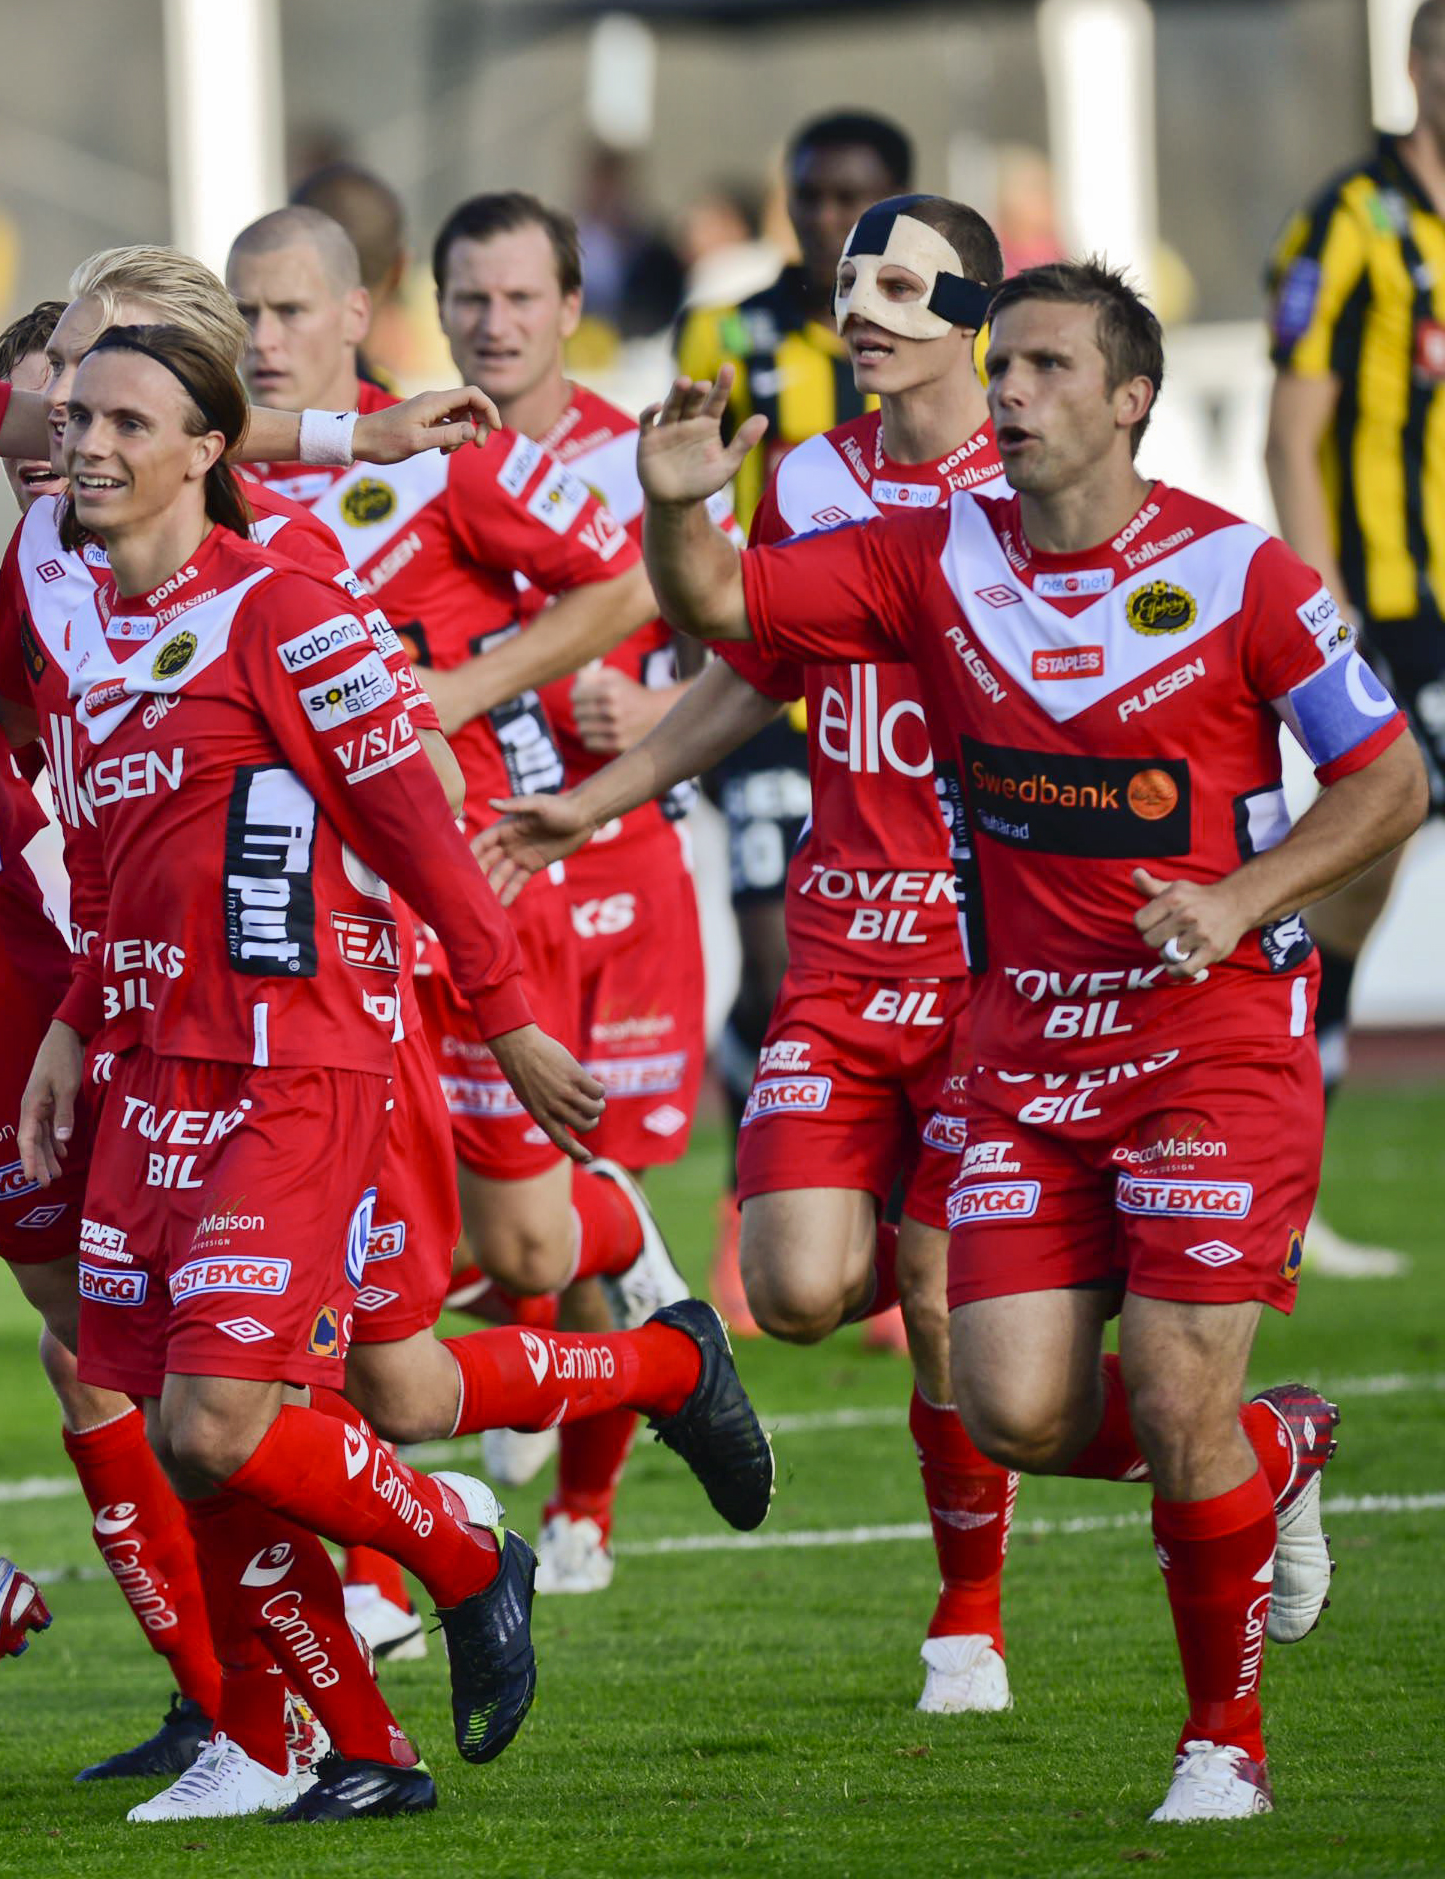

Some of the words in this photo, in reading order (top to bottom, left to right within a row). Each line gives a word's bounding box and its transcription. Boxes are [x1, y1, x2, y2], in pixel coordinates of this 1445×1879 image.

[1124, 526, 1195, 571] Folksam
[156, 587, 218, 628] Folksam
[945, 625, 1008, 704] PULSEN
[1035, 652, 1101, 674] STAPLES
[345, 677, 393, 713] BERG
[1117, 656, 1206, 723] PULSEN
[972, 761, 1121, 810] Swedbank
[846, 909, 928, 944] BIL
[862, 988, 945, 1027] BIL
[1044, 1000, 1133, 1039] BIL
[757, 1083, 818, 1110] BYGG
[1017, 1088, 1102, 1124] BIL
[1112, 1137, 1227, 1165] DecorMaison
[146, 1153, 204, 1189] BIL
[80, 1218, 128, 1251] TAPET
[549, 1340, 615, 1379] Camina
[372, 1447, 434, 1539] Camina
[101, 1538, 178, 1632] Camina
[260, 1590, 341, 1690] Camina
